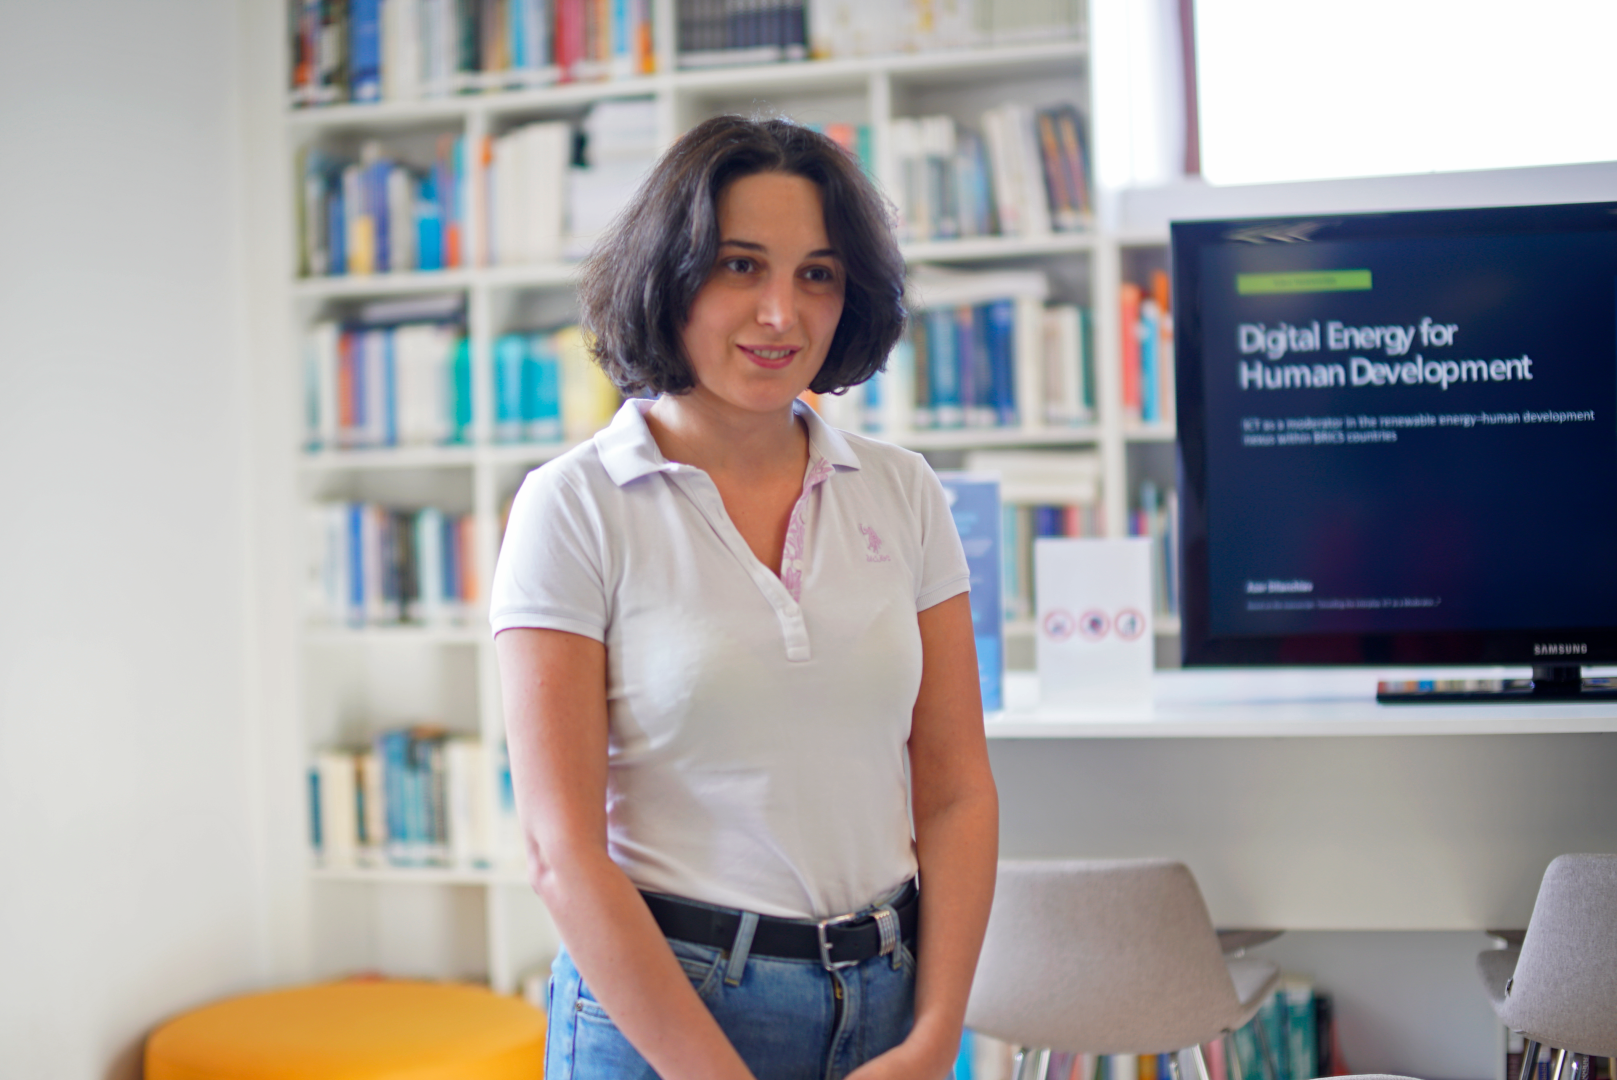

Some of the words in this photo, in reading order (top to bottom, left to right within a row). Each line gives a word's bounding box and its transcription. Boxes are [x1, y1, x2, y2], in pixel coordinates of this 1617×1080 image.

[1238, 321, 1320, 358] Digital
[1327, 320, 1415, 355] Energy
[1418, 317, 1458, 347] for
[1239, 358, 1346, 390] Human
[1350, 354, 1534, 390] Development
[1346, 416, 1357, 428] in
[1358, 415, 1377, 428] the
[1379, 413, 1436, 427] renewable
[1523, 410, 1595, 425] development
[1313, 431, 1344, 443] BRICS
[1346, 430, 1398, 444] countries
[1533, 643, 1588, 656] SAMSUNG
